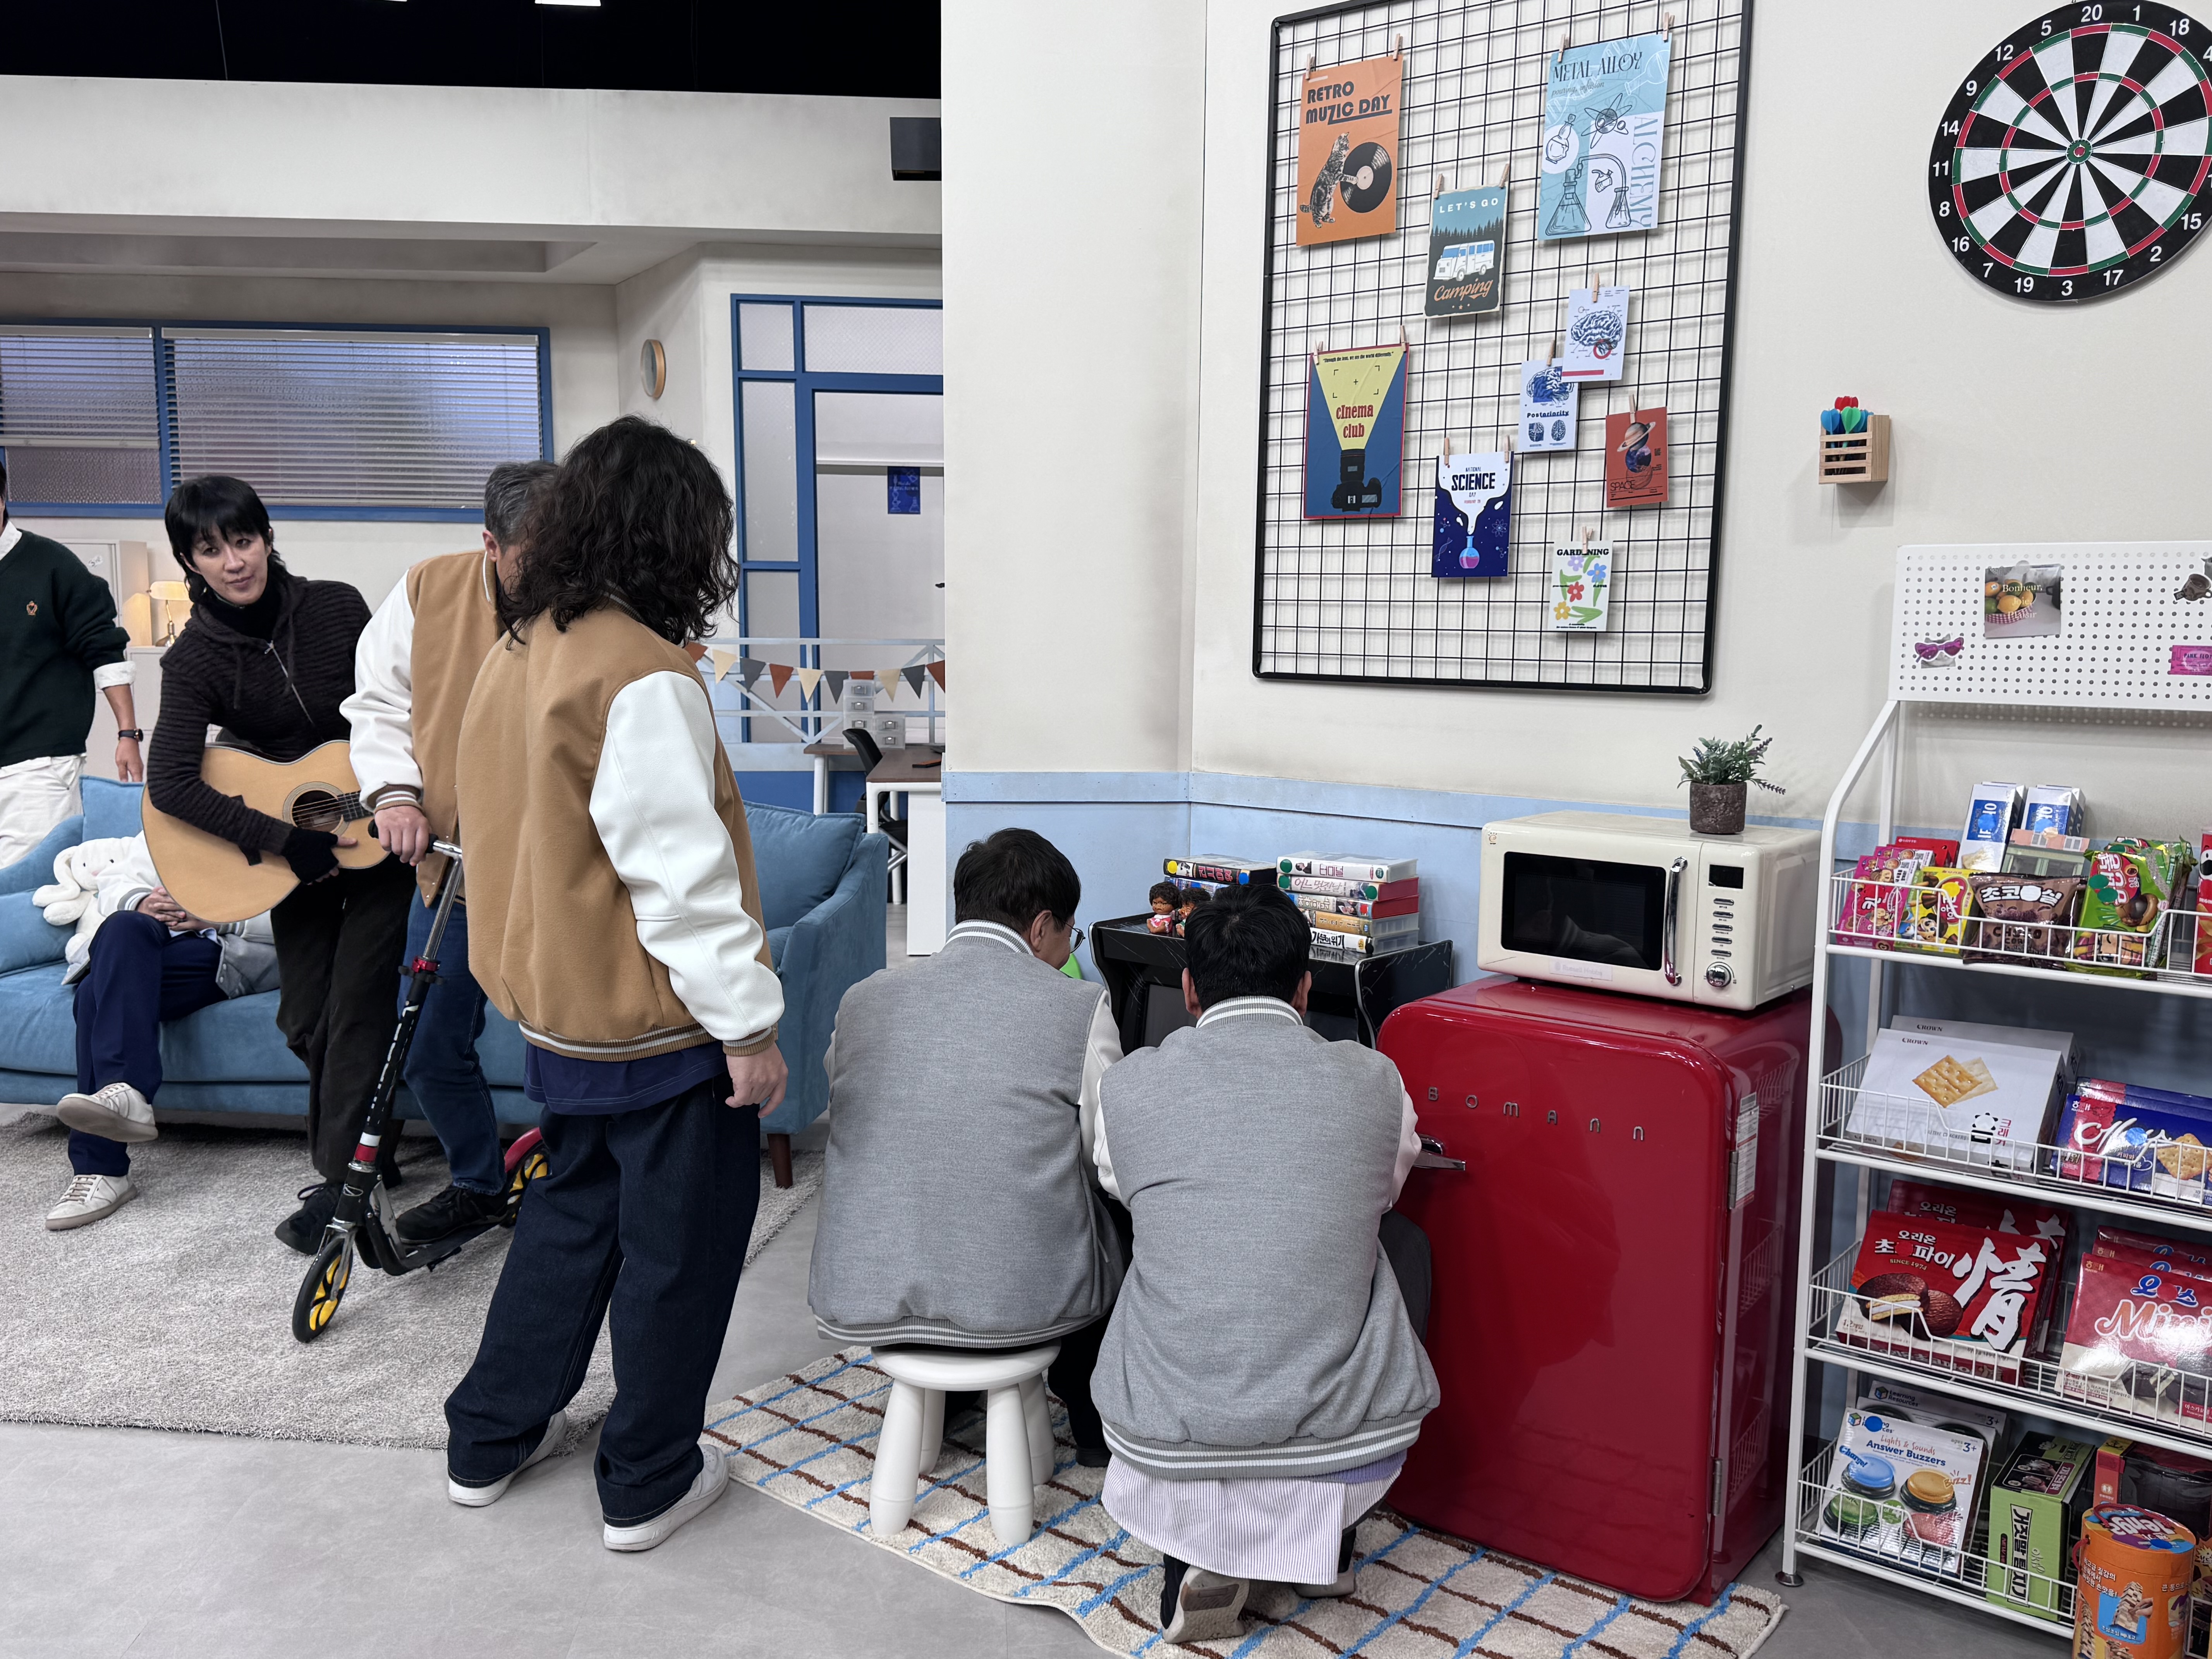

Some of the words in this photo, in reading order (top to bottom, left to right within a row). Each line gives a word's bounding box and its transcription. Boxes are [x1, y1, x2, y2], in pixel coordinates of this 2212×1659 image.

[2081, 5, 2102, 22] 20
[2133, 5, 2140, 21] 1
[2041, 20, 2051, 36] 5
[2170, 19, 2189, 36] 18
[1996, 45, 2013, 61] 12
[2203, 46, 2212, 61] 4
[1553, 60, 1592, 83] METAL
[1597, 52, 1642, 76] ALLOY
[1307, 81, 1354, 104] RETRO
[1966, 81, 1977, 96] 9
[1306, 101, 1354, 125] MUZIC
[1359, 94, 1391, 114] DAY
[1942, 120, 1959, 136] 14
[1933, 161, 1948, 176] 11
[1439, 201, 1476, 213] LET'S
[1481, 198, 1499, 207] GO
[1939, 201, 1949, 216] 8
[2181, 213, 2201, 230] 15
[1952, 237, 1969, 252] 16
[2150, 246, 2161, 261] 2
[1983, 263, 1993, 277] 7
[2104, 270, 2123, 285] 17
[1434, 278, 1493, 301] Camping
[2014, 277, 2033, 292] 19
[2062, 280, 2072, 295] 3
[1343, 423, 1365, 438] club
[1451, 472, 1496, 491] SCIENCE
[1610, 479, 1636, 491] SPACE
[2002, 583, 2043, 592] Bonheur,
[1319, 863, 1344, 877] 터미널
[1980, 885, 2063, 907] 초코실
[1920, 1201, 1957, 1217] 오리온
[1898, 1230, 1936, 1245] 오리온
[1874, 1238, 1956, 1269] 초파이
[1911, 1261, 1927, 1271] 1974
[1953, 1237, 2047, 1351] 情
[2130, 1274, 2199, 1307] 오스
[1888, 1395, 1919, 1407] Resources
[1889, 1389, 1916, 1401] Learning
[1986, 1415, 2000, 1426] 3+
[1881, 1435, 1901, 1448] Lights
[1912, 1442, 1936, 1455] Sounds
[1963, 1442, 1977, 1453] 3+
[1839, 1445, 1867, 1468] Charge!
[1866, 1439, 1905, 1456] Answer
[1906, 1449, 1946, 1467] Buzzers
[2013, 1508, 2030, 1555] 거짓말
